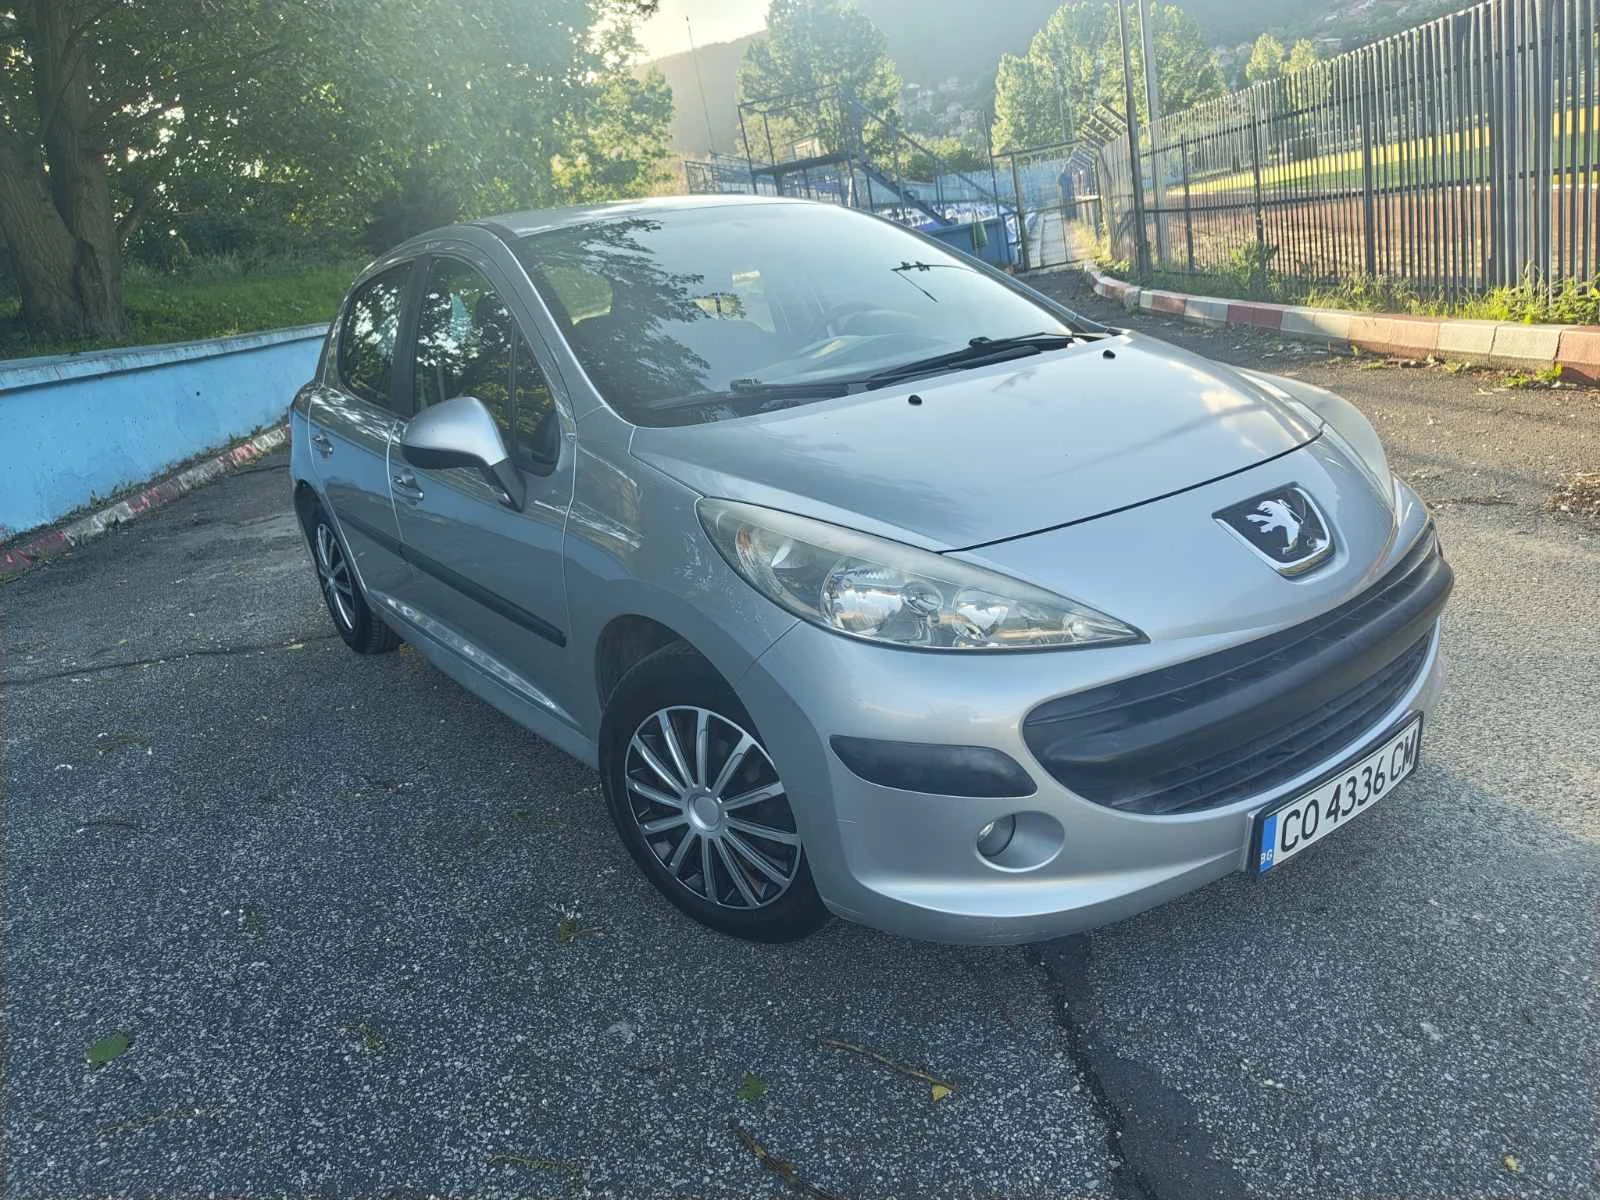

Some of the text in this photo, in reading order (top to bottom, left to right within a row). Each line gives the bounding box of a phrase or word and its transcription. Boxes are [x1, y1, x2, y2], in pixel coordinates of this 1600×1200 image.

[1280, 728, 1417, 852] CO 4336 CM
